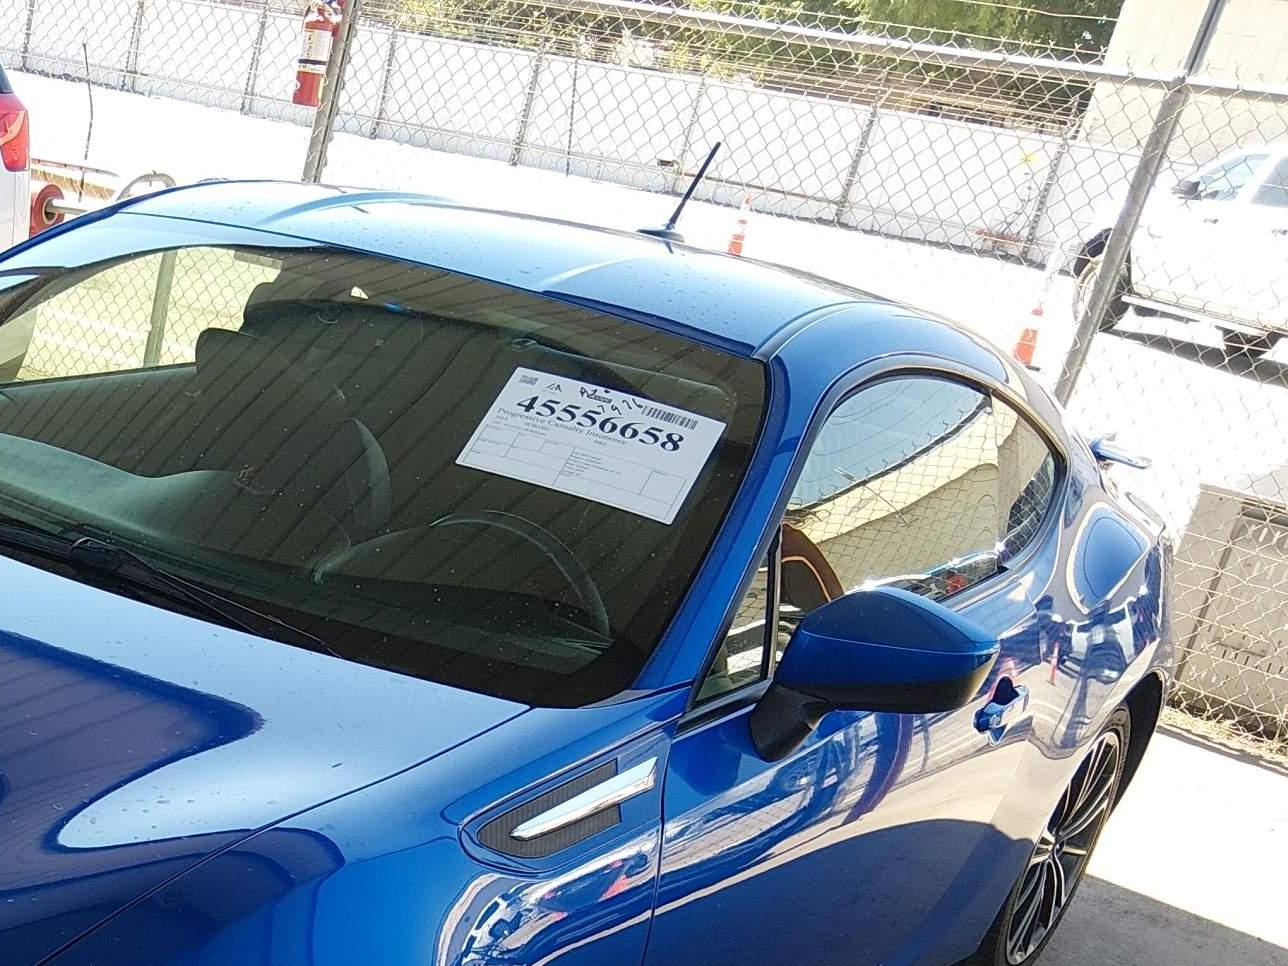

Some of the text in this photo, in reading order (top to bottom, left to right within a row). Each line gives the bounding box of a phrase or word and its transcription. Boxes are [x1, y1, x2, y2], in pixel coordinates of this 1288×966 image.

[497, 407, 545, 425] Progressive
[548, 418, 585, 434] Casualty
[586, 430, 628, 446] Insurance
[516, 395, 685, 452] 45556658
